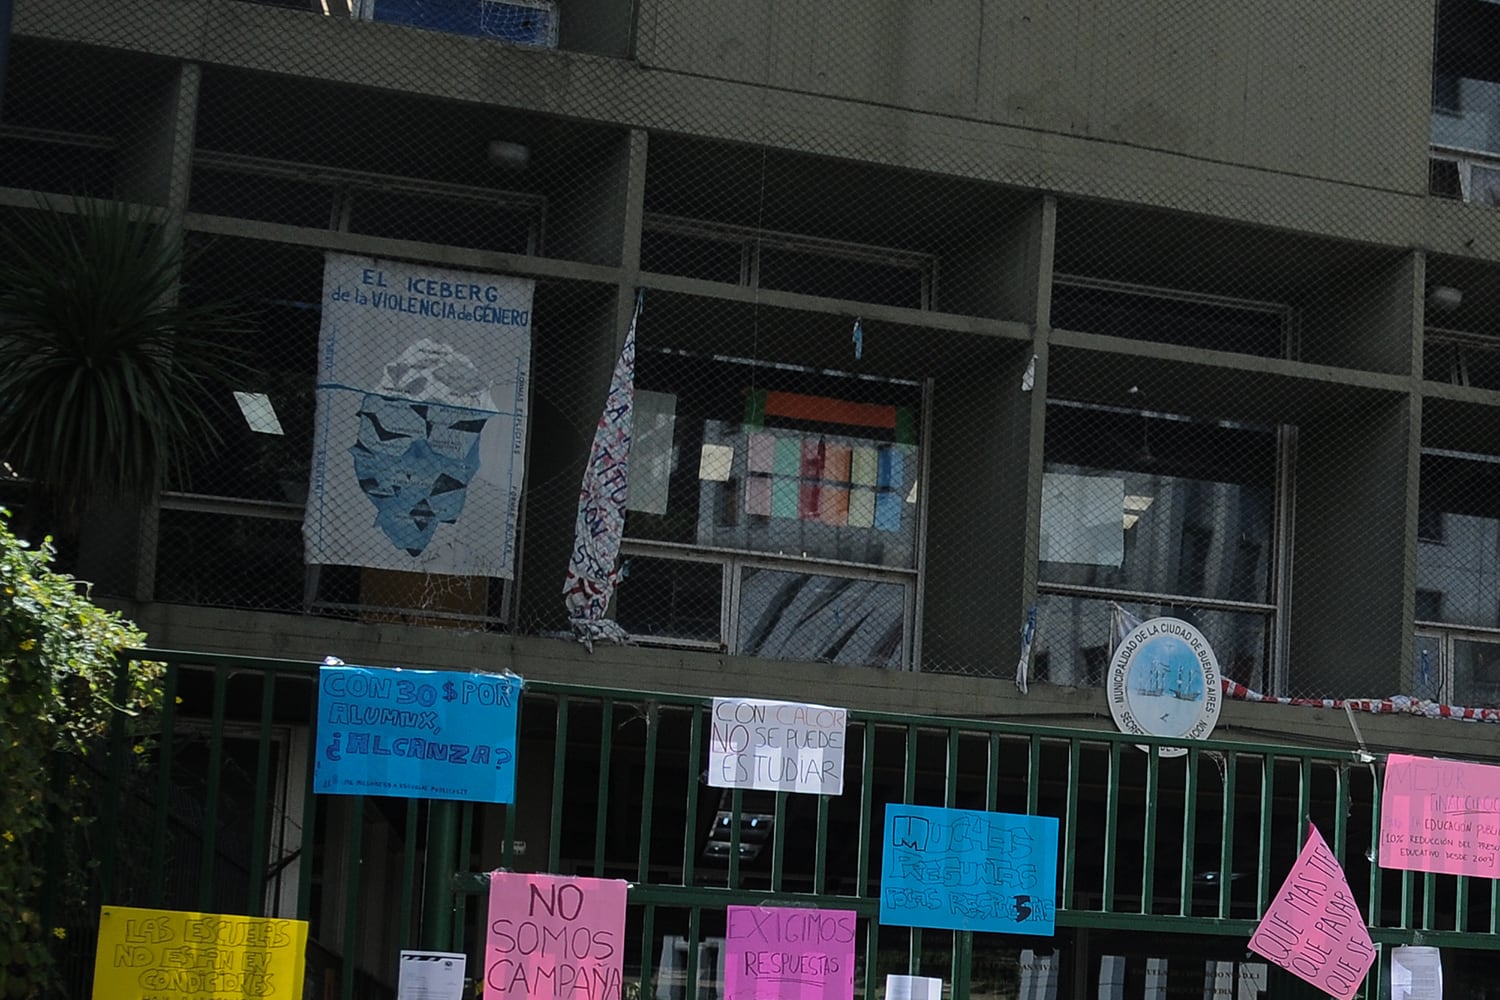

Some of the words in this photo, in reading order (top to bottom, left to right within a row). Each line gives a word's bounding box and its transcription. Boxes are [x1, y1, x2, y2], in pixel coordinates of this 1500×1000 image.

[363, 269, 387, 287] EL
[407, 277, 498, 303] ICEBERG
[331, 287, 349, 301] de
[355, 288, 368, 305] la
[372, 290, 456, 320] VIOLENCIA
[457, 308, 473, 321] de
[1135, 629, 1148, 644] DE
[1146, 625, 1159, 637] LA
[1160, 623, 1193, 641] CIUDAD
[1190, 638, 1203, 651] DE
[1113, 640, 1138, 704] MUNICIPALIDAD
[1198, 650, 1216, 686] BUENOS
[323, 672, 392, 699] CON
[396, 680, 438, 707] 30
[462, 680, 514, 708] POR
[1206, 687, 1217, 714] AIRES
[716, 702, 766, 724] CON
[776, 705, 845, 728] CALOR
[325, 732, 512, 770] ¿ALCANZA?
[712, 722, 749, 754] NO
[755, 727, 780, 748] SE
[786, 728, 842, 749] PUEDE
[722, 754, 839, 784] ESTUDIAR
[1400, 848, 1440, 859] EDUCATIVO
[1446, 852, 1468, 862] DESDE
[1458, 838, 1471, 849] DEL
[529, 883, 584, 921] NO
[125, 916, 175, 944] LAS
[184, 917, 290, 948] ESCUELAS
[492, 920, 614, 960] SOMOS
[727, 909, 856, 944] EXIGIMOS
[1291, 938, 1333, 978] QUE
[1314, 890, 1356, 942] PASAR
[113, 944, 155, 968] NO
[241, 950, 272, 973] EN
[745, 951, 840, 977] RESPUESTAS
[1325, 956, 1361, 996] QUE
[1346, 936, 1373, 961] SE
[138, 968, 276, 997] CONDICIONES
[487, 959, 621, 1000] CAMPAÑA
